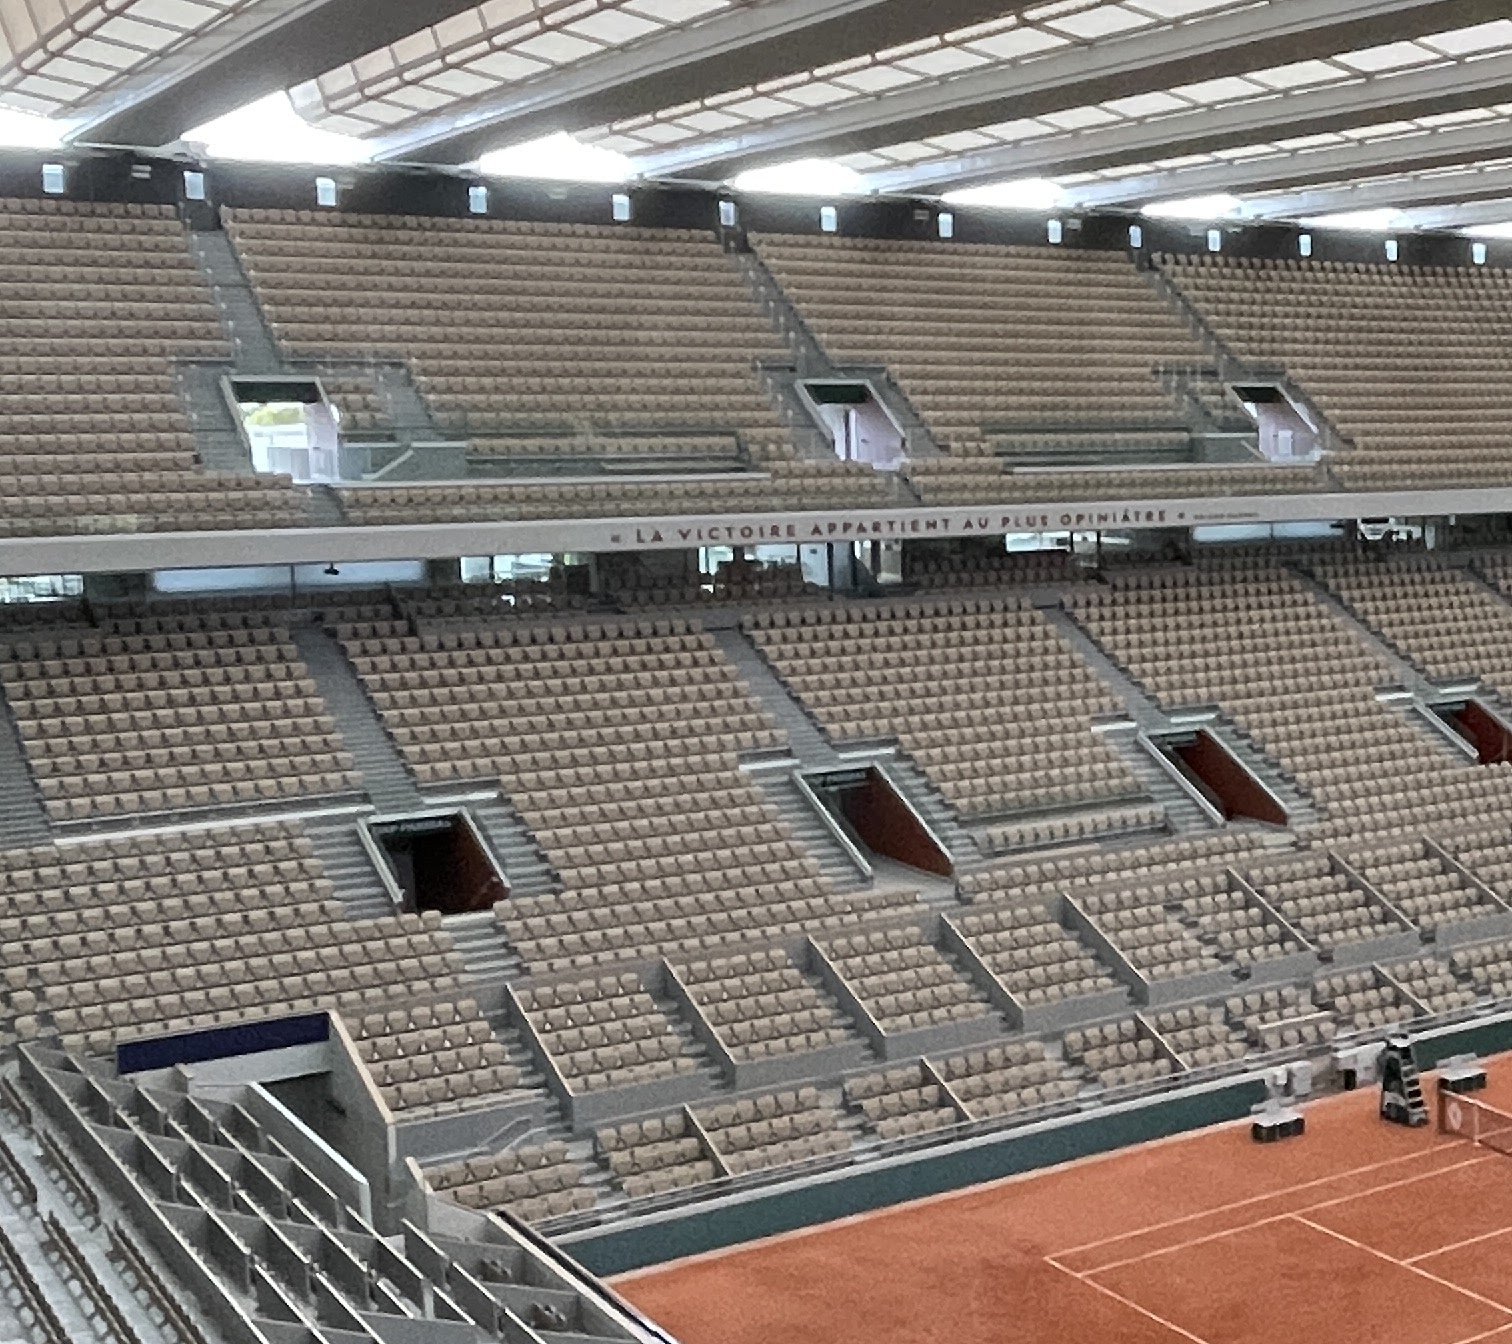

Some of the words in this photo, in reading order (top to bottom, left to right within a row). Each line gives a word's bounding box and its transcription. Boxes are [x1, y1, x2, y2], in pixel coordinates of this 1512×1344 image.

[636, 528, 664, 544] LA
[677, 524, 796, 541] VICTOIRE
[810, 518, 950, 536] APPARTIENT
[962, 517, 990, 530] AU
[1001, 514, 1049, 528] PLUS
